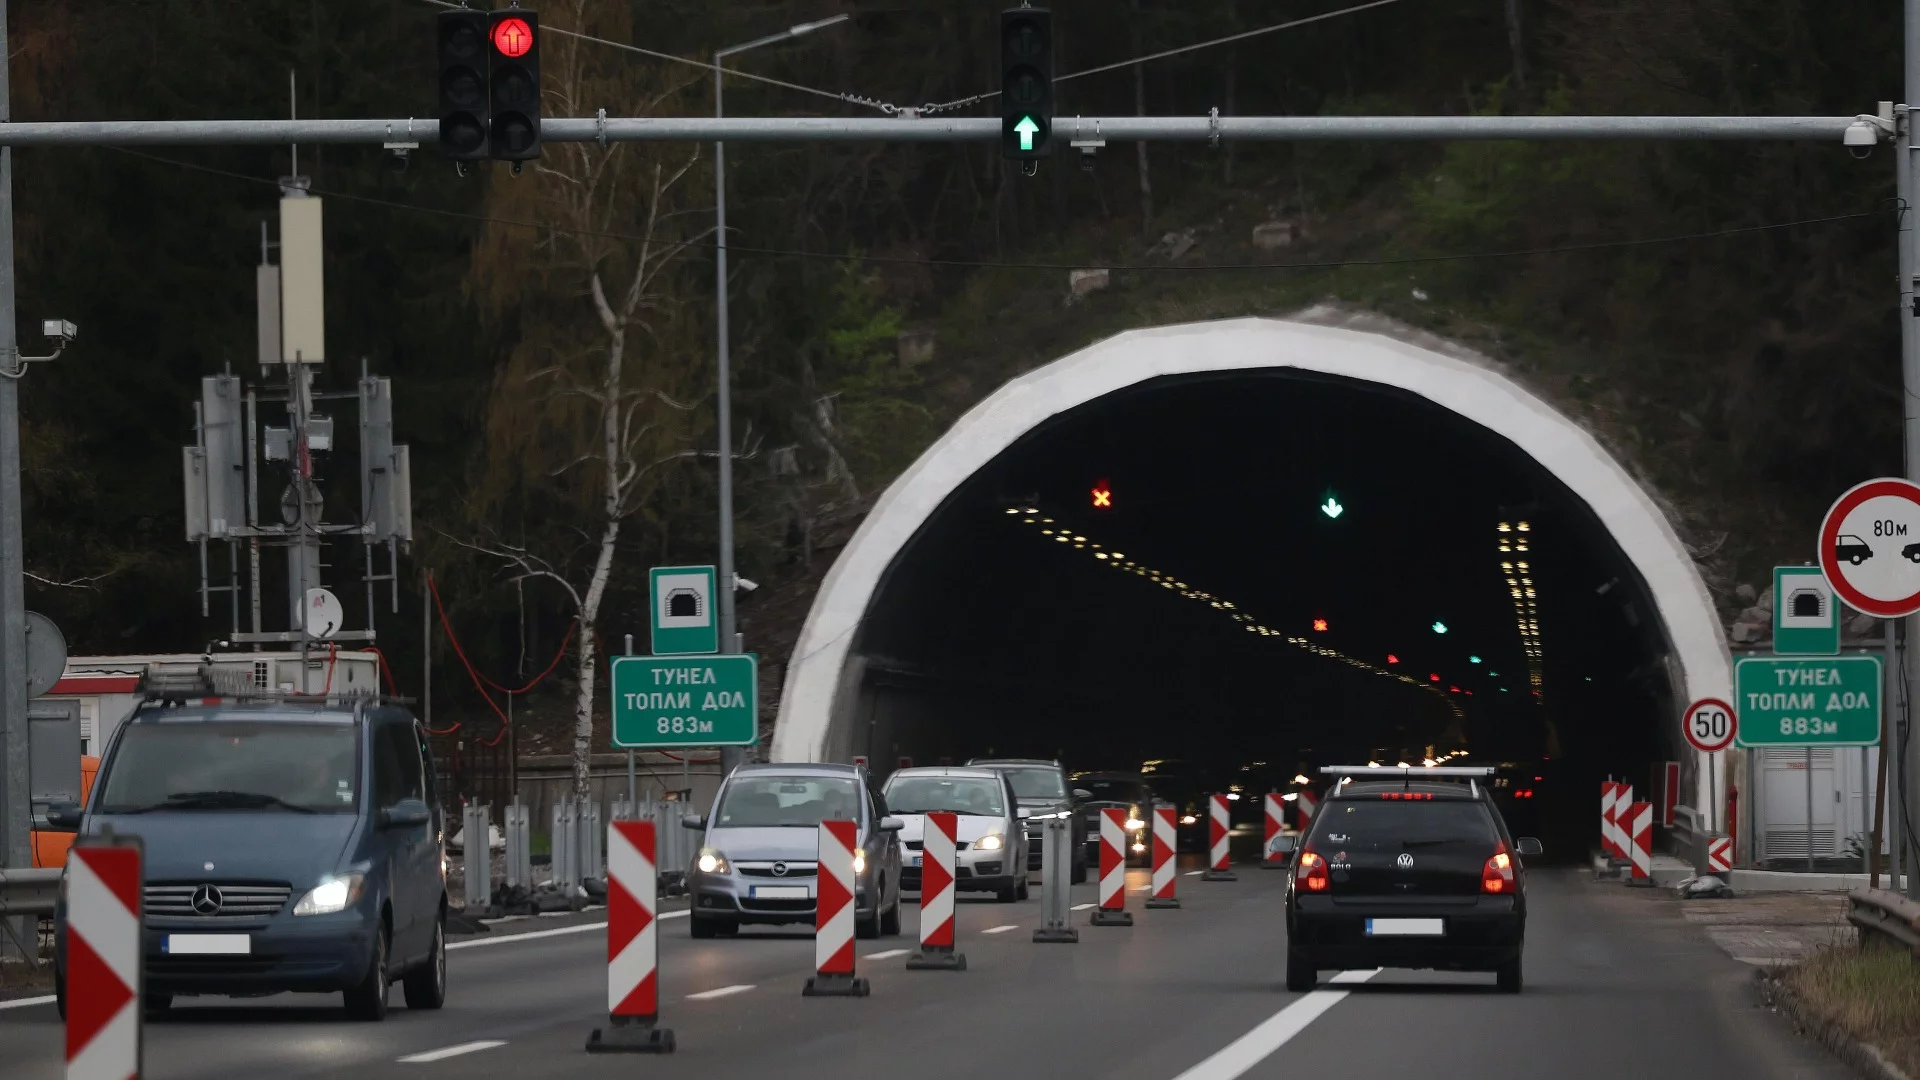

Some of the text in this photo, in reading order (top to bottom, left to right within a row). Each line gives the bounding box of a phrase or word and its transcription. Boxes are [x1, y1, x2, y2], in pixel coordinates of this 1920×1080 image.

[1873, 519, 1907, 537] 80м
[651, 667, 717, 685] ТУНЕЛ
[1774, 668, 1842, 686] ТУНЕЛ
[623, 691, 746, 711] ТОПЛИ ДОЛ
[1747, 692, 1870, 712] ТОПЛИ ДОЛ
[656, 716, 713, 734] 883м
[1695, 711, 1726, 738] 50
[1779, 716, 1838, 735] 883м
